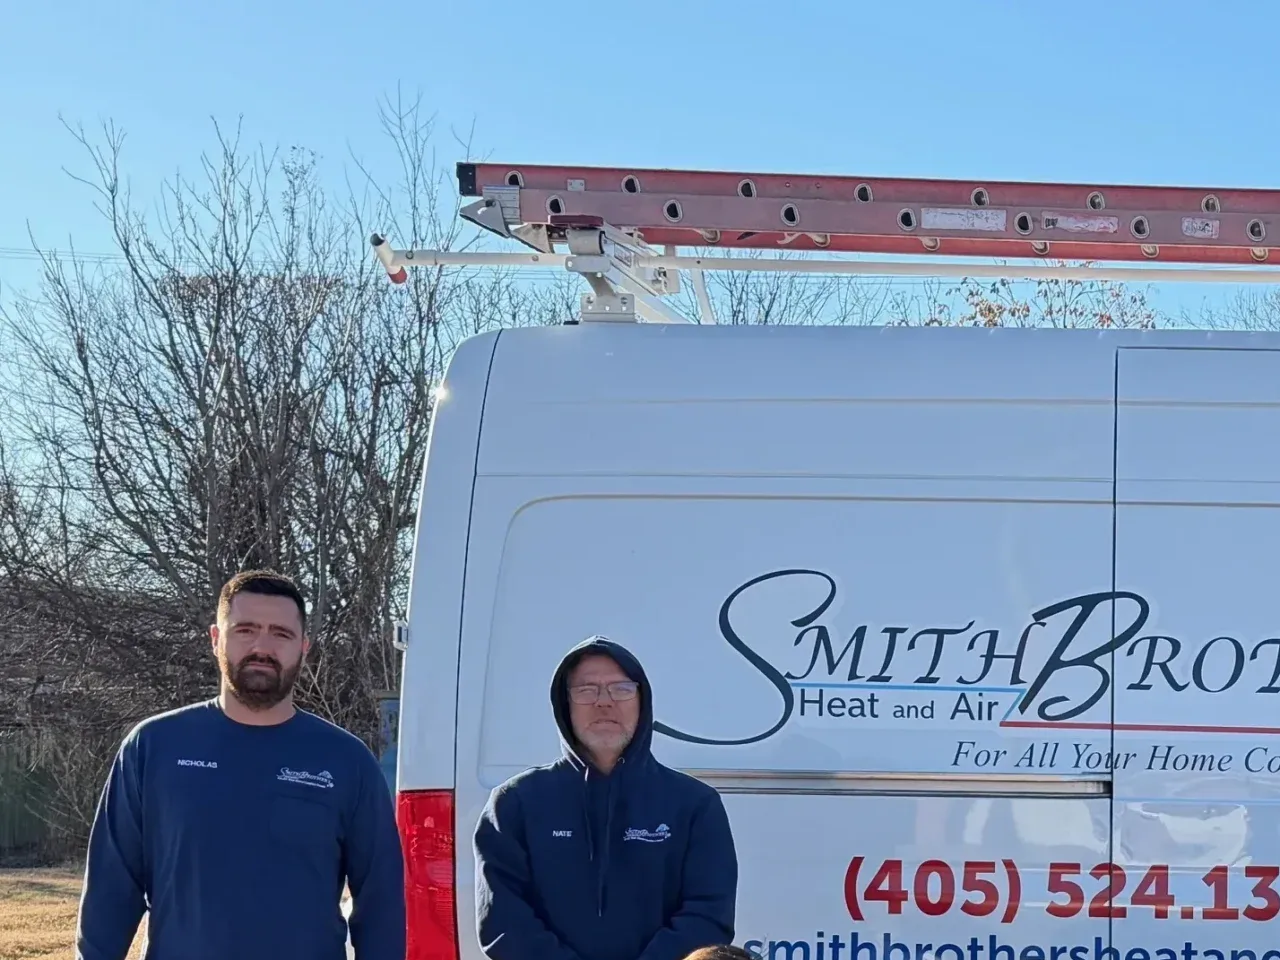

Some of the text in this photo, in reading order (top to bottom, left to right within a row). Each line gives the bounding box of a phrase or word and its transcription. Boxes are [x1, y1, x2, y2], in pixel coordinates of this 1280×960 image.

[653, 569, 1047, 745] SMITH
[800, 688, 998, 721] Heat and Air
[177, 759, 218, 769] NICHOLAS
[951, 741, 1007, 767] For
[1014, 742, 1059, 768] All
[1071, 744, 1136, 772] Your
[1146, 745, 1232, 773] Home
[844, 856, 1022, 923] (405)
